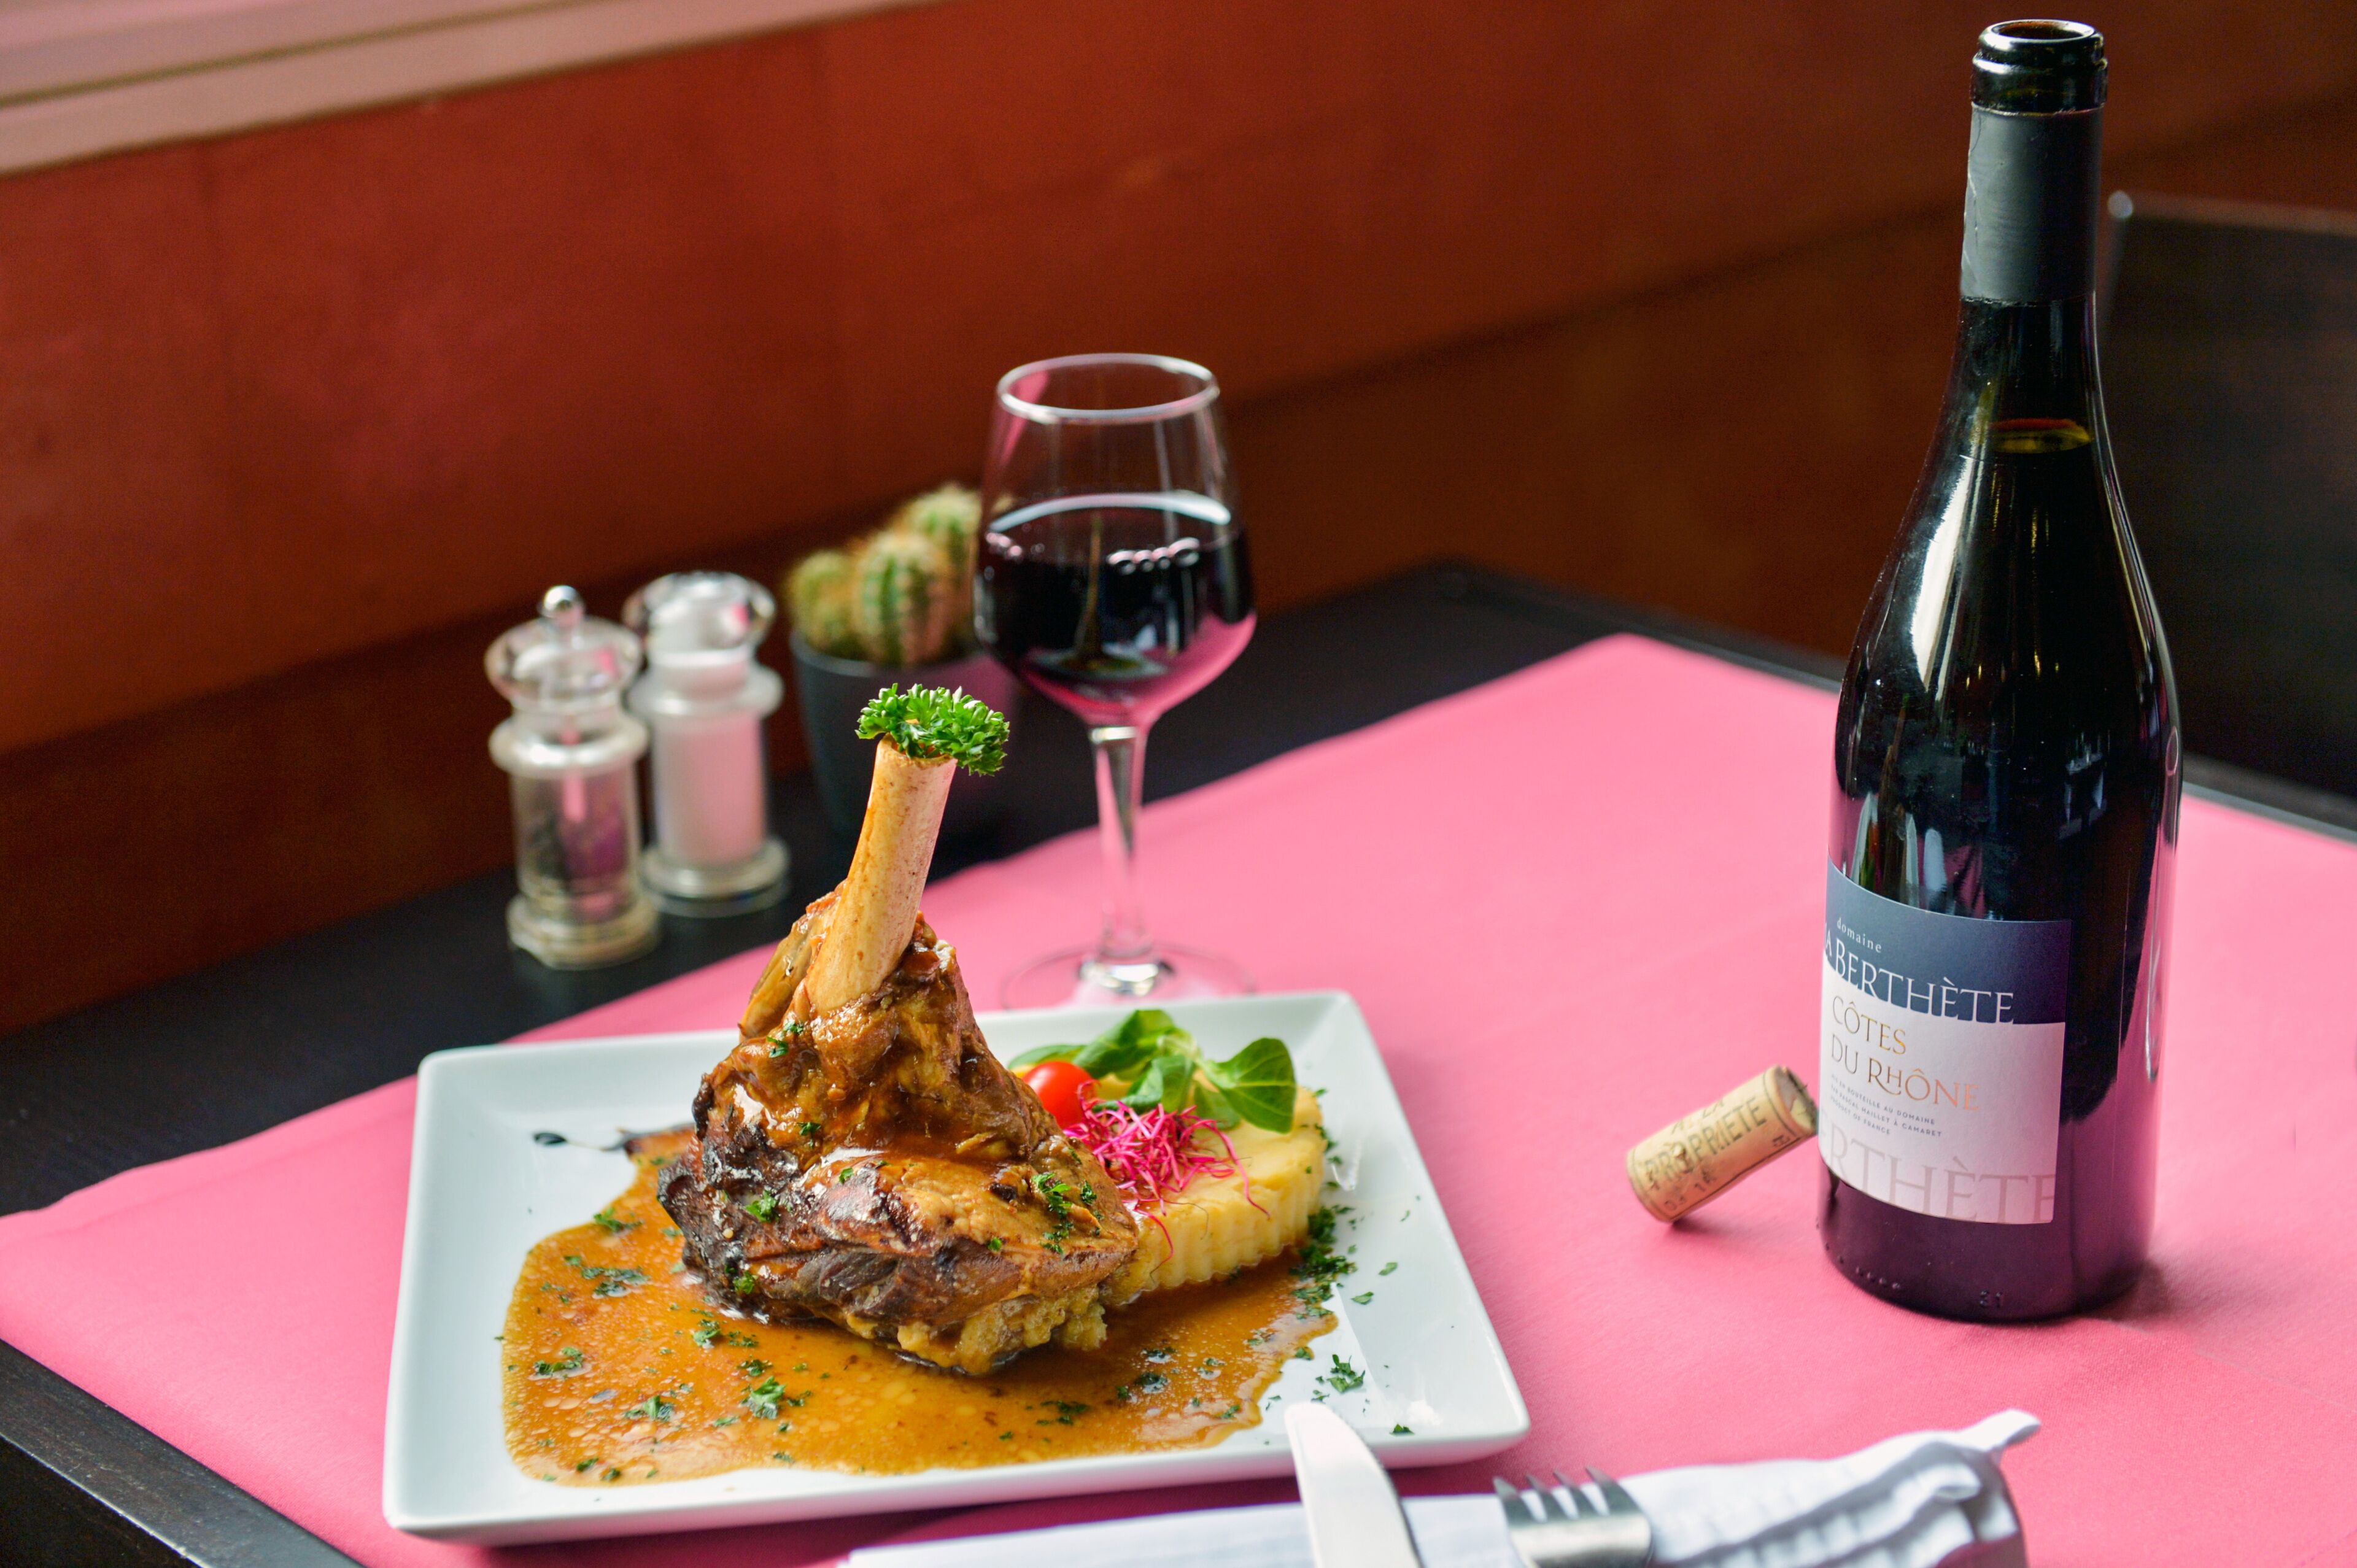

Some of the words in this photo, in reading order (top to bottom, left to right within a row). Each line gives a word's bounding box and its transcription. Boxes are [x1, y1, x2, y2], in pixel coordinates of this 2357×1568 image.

[1837, 917, 1882, 952] domaine
[1836, 938, 2014, 1025] BERTHÈTE
[1833, 996, 1906, 1055] CÔTES
[1832, 1034, 1859, 1075] DU
[1868, 1057, 1981, 1110] RHÔNE
[1840, 1092, 1859, 1110] PASCAL
[1861, 1106, 1891, 1124] MAILLET
[1902, 1122, 1942, 1137] CAMARET
[1848, 1086, 1881, 1109] BOUTEILLE
[1897, 1110, 1935, 1125] DOMAINE
[1864, 1118, 1891, 1135] FRANCE
